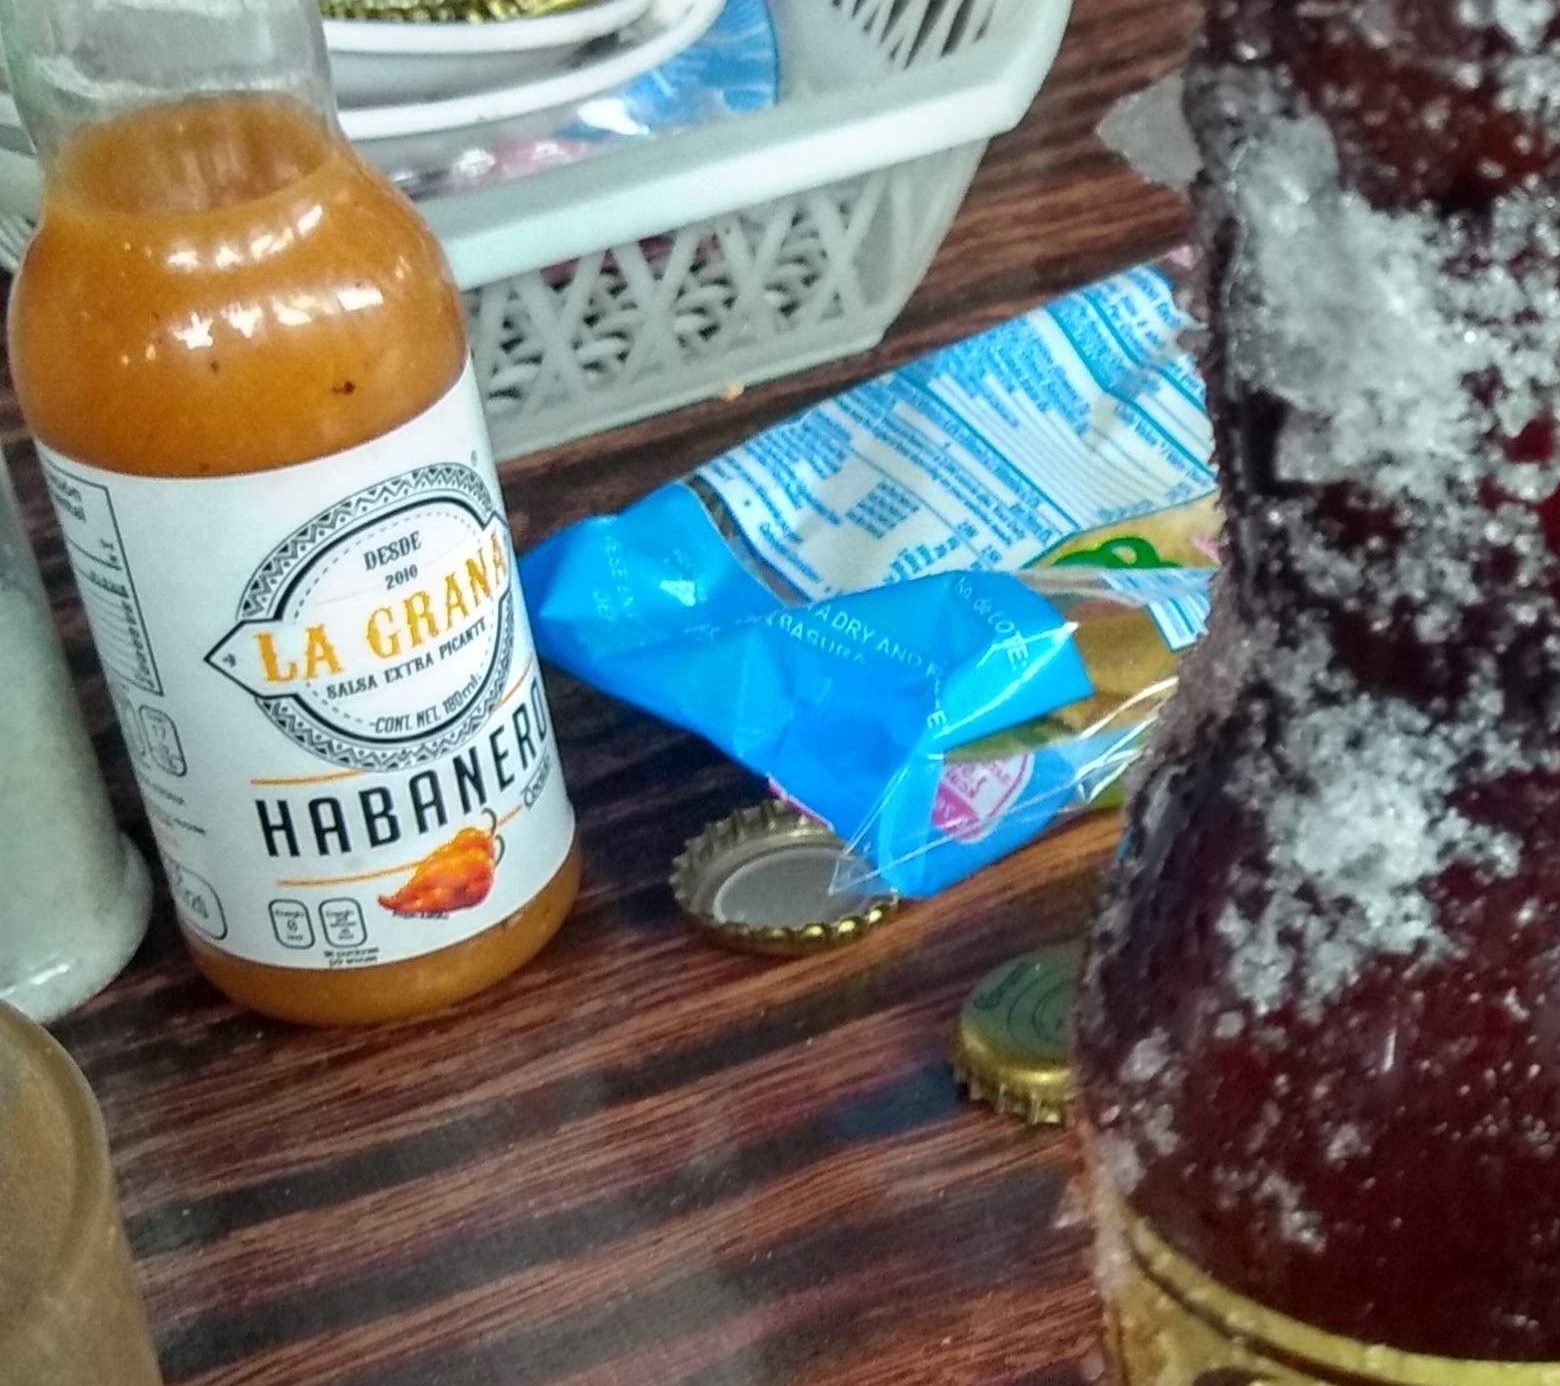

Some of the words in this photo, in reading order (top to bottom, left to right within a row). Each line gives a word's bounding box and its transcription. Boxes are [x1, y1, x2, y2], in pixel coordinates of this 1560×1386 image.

[362, 530, 421, 571] DESDE
[384, 563, 419, 591] 2010
[831, 611, 876, 645] DRY
[253, 623, 344, 686] LA
[326, 677, 379, 701] SALSA
[384, 654, 435, 683] EXTRA
[255, 676, 549, 858] HABANERO
